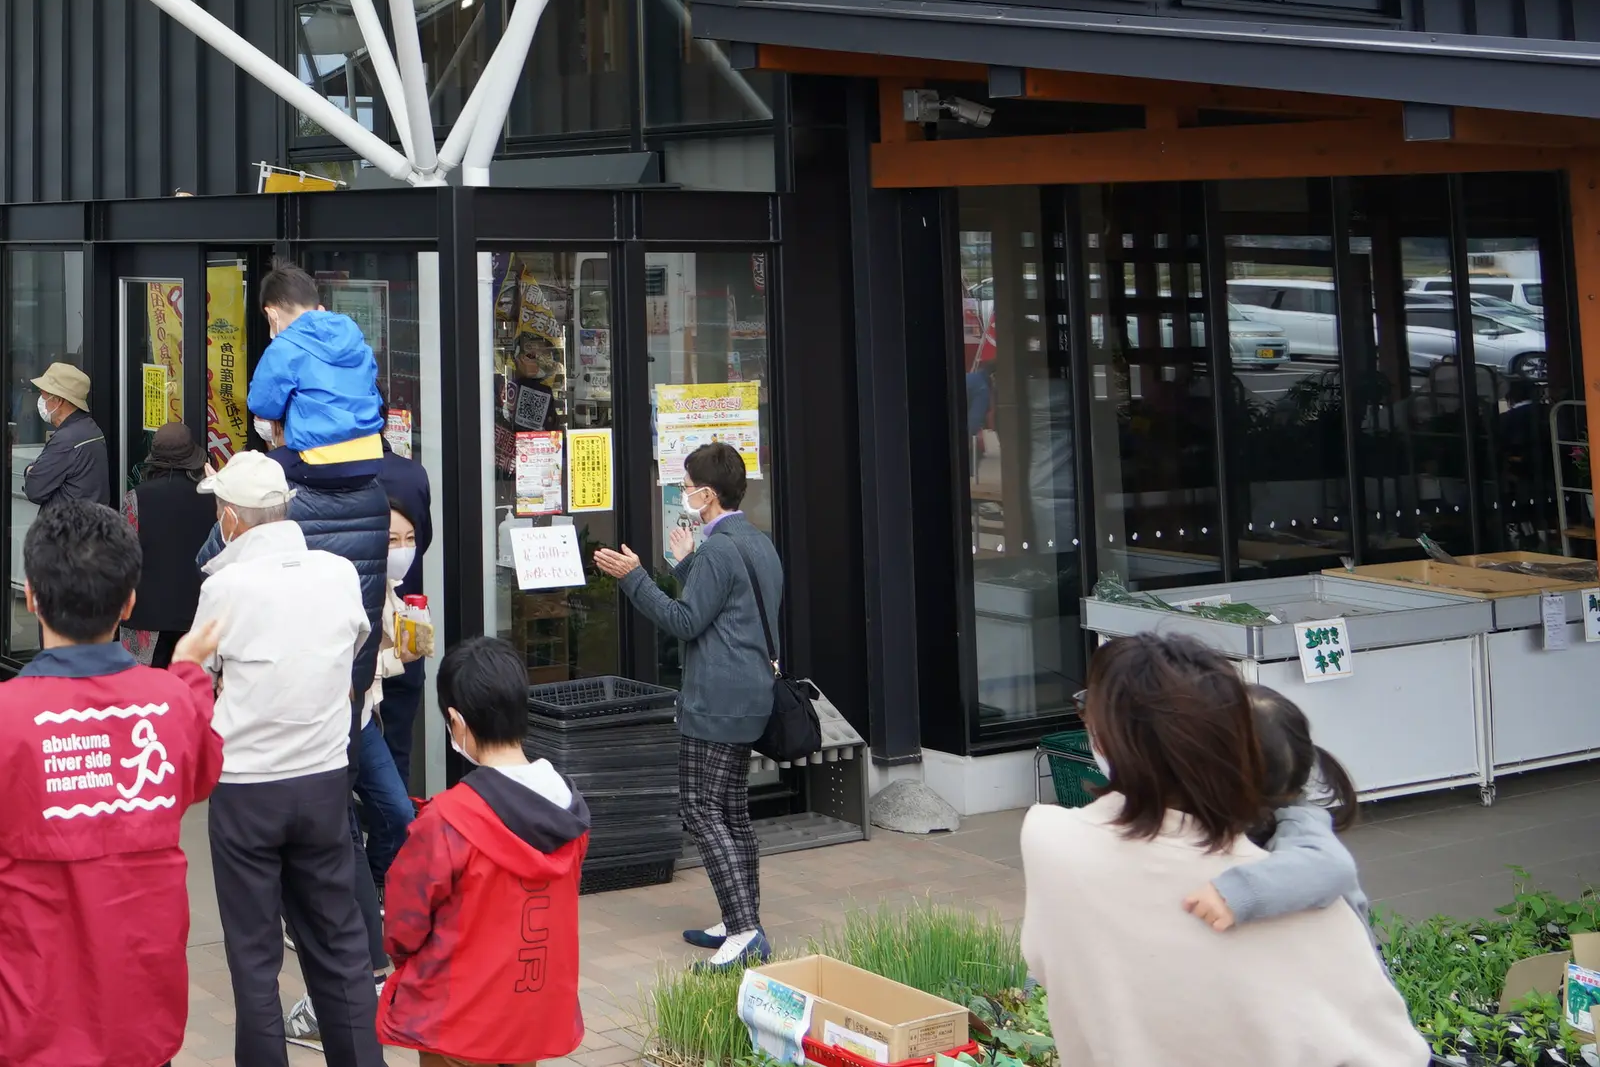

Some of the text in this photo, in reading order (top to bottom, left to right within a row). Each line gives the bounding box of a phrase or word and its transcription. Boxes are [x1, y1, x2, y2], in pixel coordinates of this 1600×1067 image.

[1314, 648, 1344, 674] ネギ
[42, 733, 110, 754] abukuma
[44, 751, 111, 773] river side
[46, 771, 113, 792] marathon
[748, 995, 797, 1021] ホワイトスター
